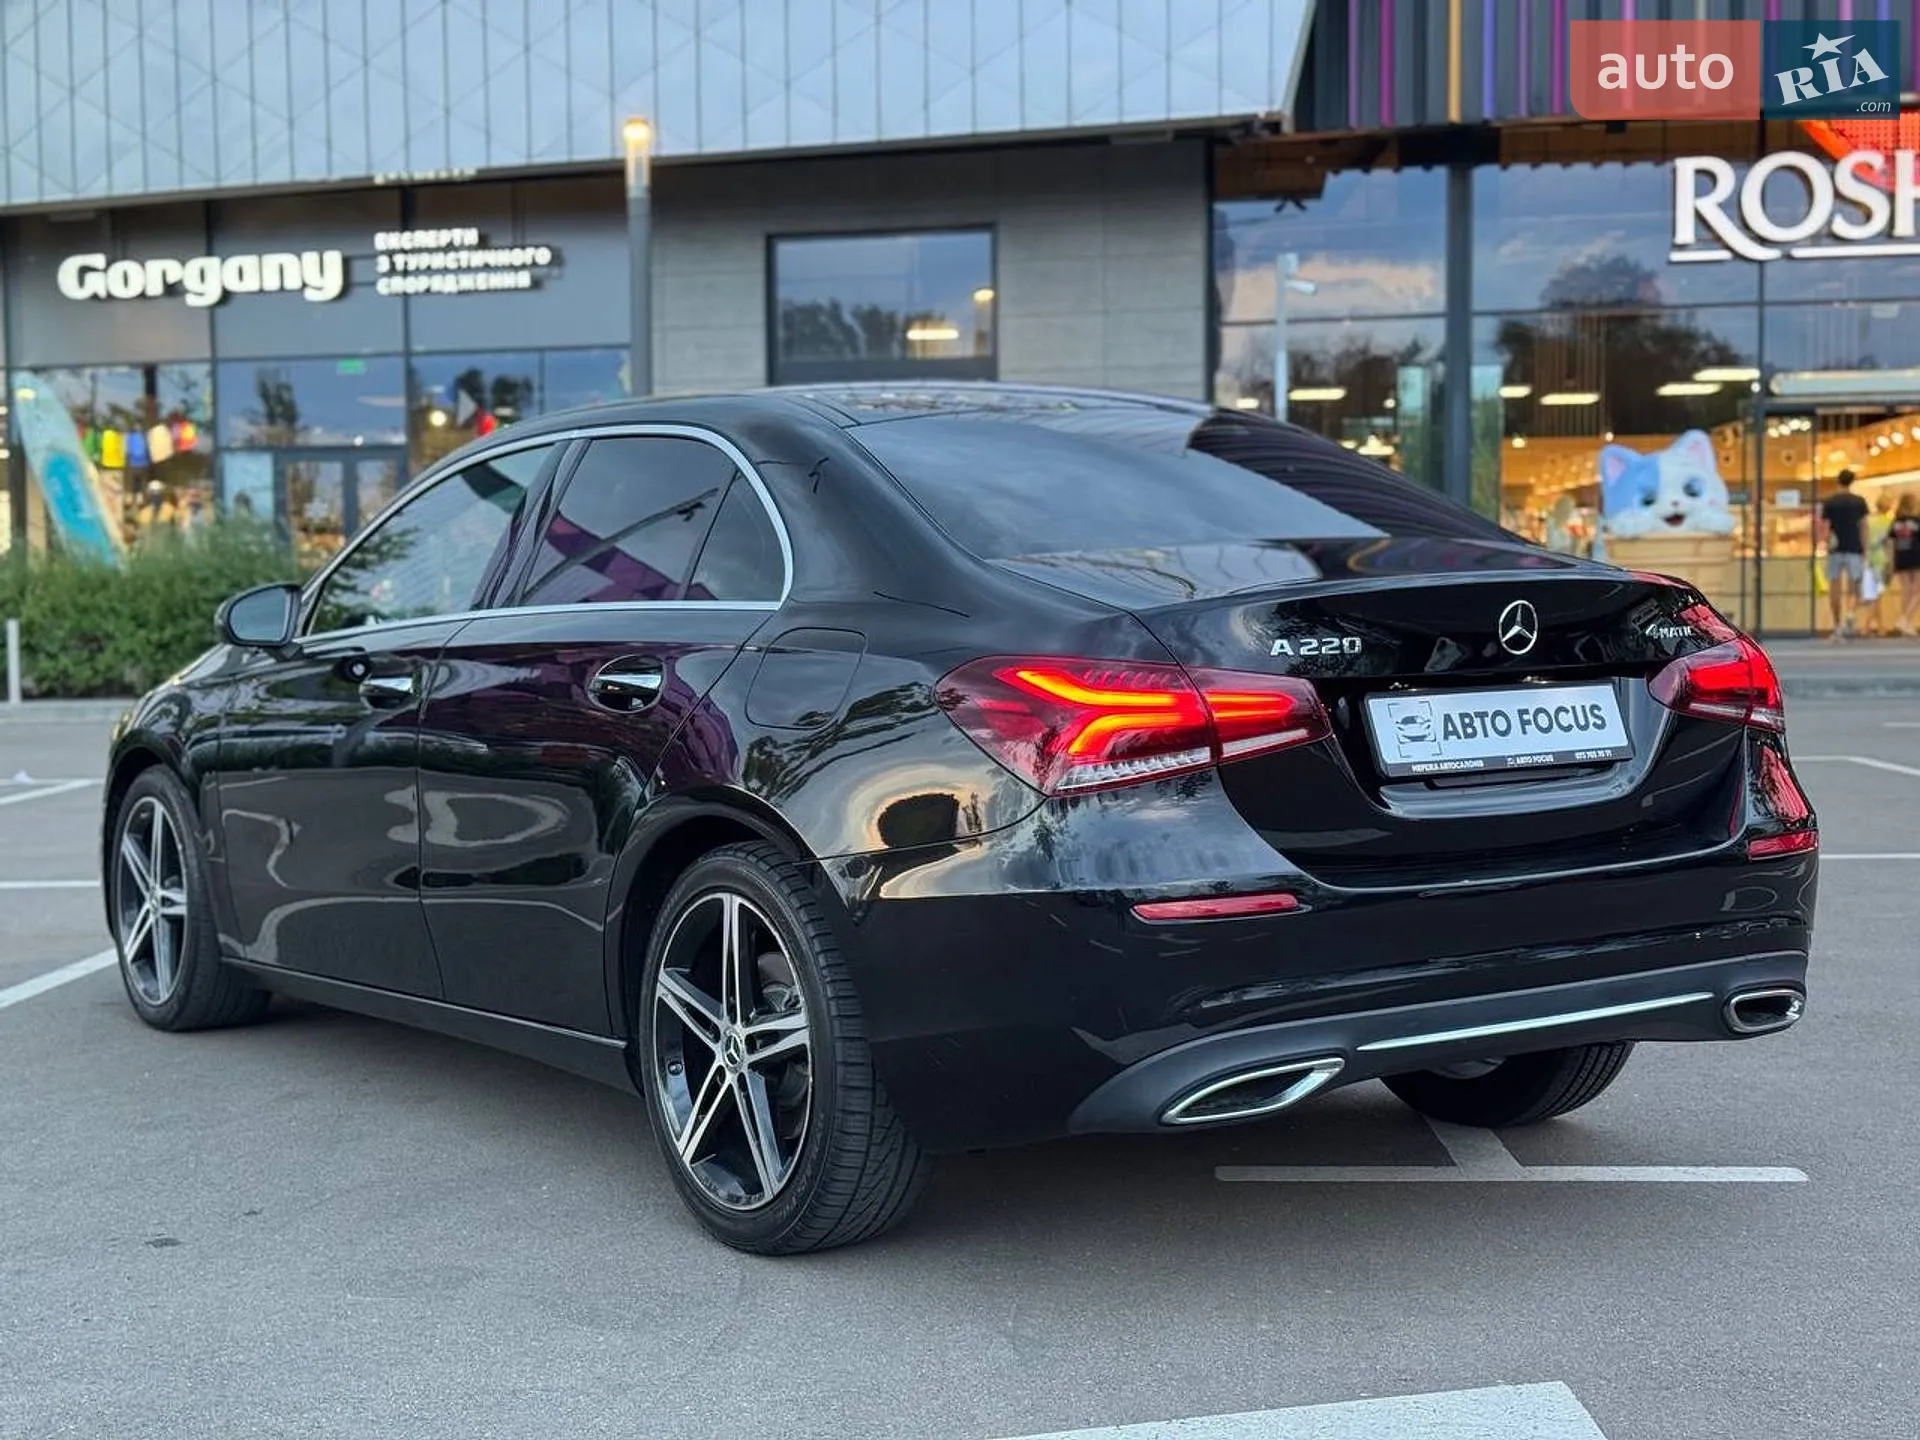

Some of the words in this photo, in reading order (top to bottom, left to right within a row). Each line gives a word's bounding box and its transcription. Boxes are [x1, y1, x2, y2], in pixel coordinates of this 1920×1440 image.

[57, 249, 344, 308] Gorgany
[1270, 638, 1295, 656] A
[1299, 636, 1362, 656] 220
[1516, 703, 1607, 736] FOCUS
